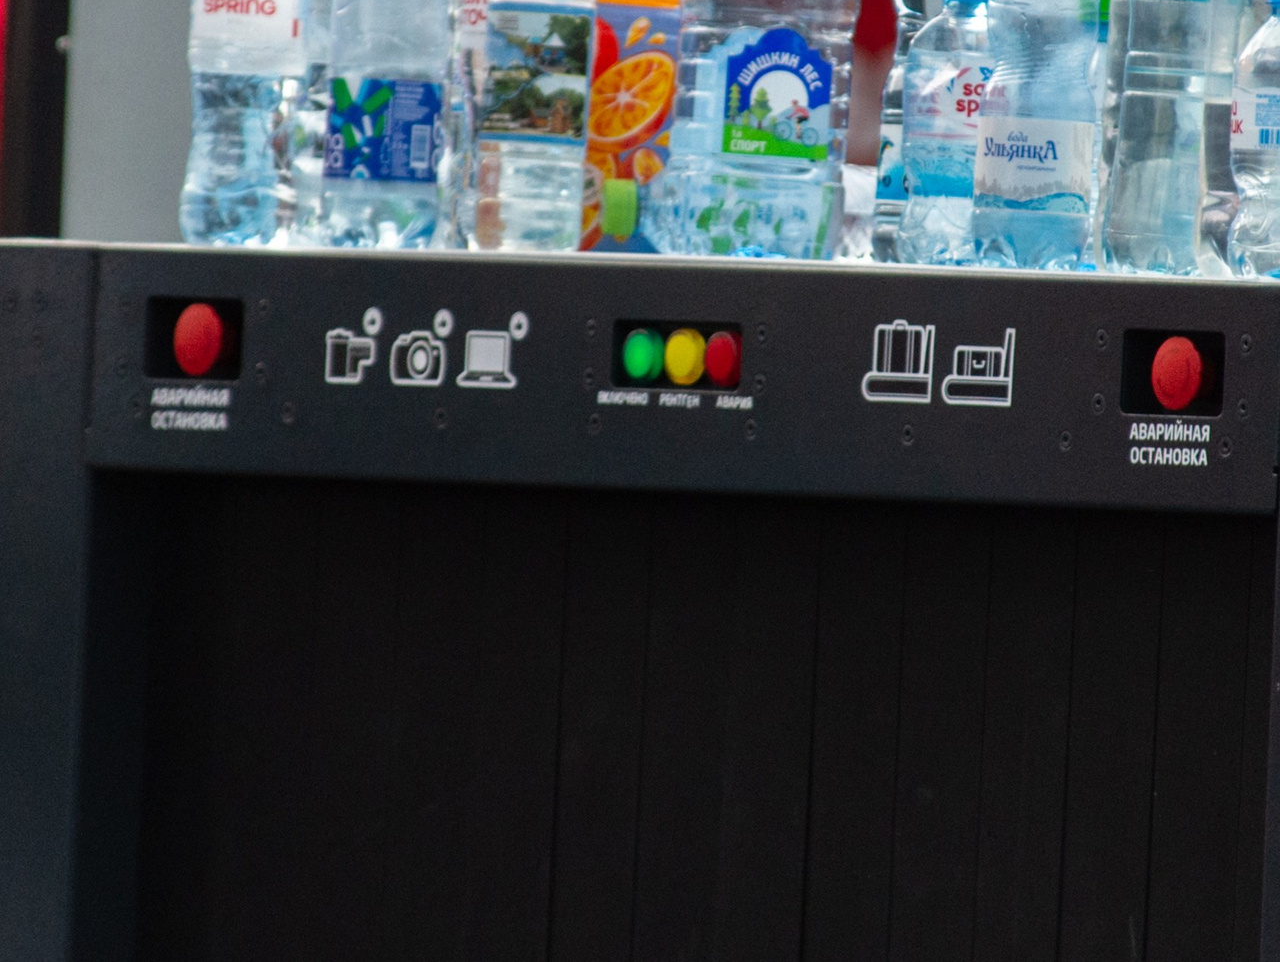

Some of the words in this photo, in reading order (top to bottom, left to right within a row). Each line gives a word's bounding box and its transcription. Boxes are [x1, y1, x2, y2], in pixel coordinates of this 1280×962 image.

[738, 51, 800, 87] ШИШКИН
[799, 63, 823, 92] ЛЕС
[730, 139, 767, 152] СПОРТ
[151, 384, 230, 407] АВАРИЙНАЯ
[658, 392, 701, 409] РЕНТГЕН
[715, 394, 753, 409] АВАРИЯ
[151, 410, 228, 430] ОСТАНОВКА
[1129, 419, 1210, 442] АВАРИЙНАЯ
[1130, 446, 1208, 466] ОСТАНОВКА
